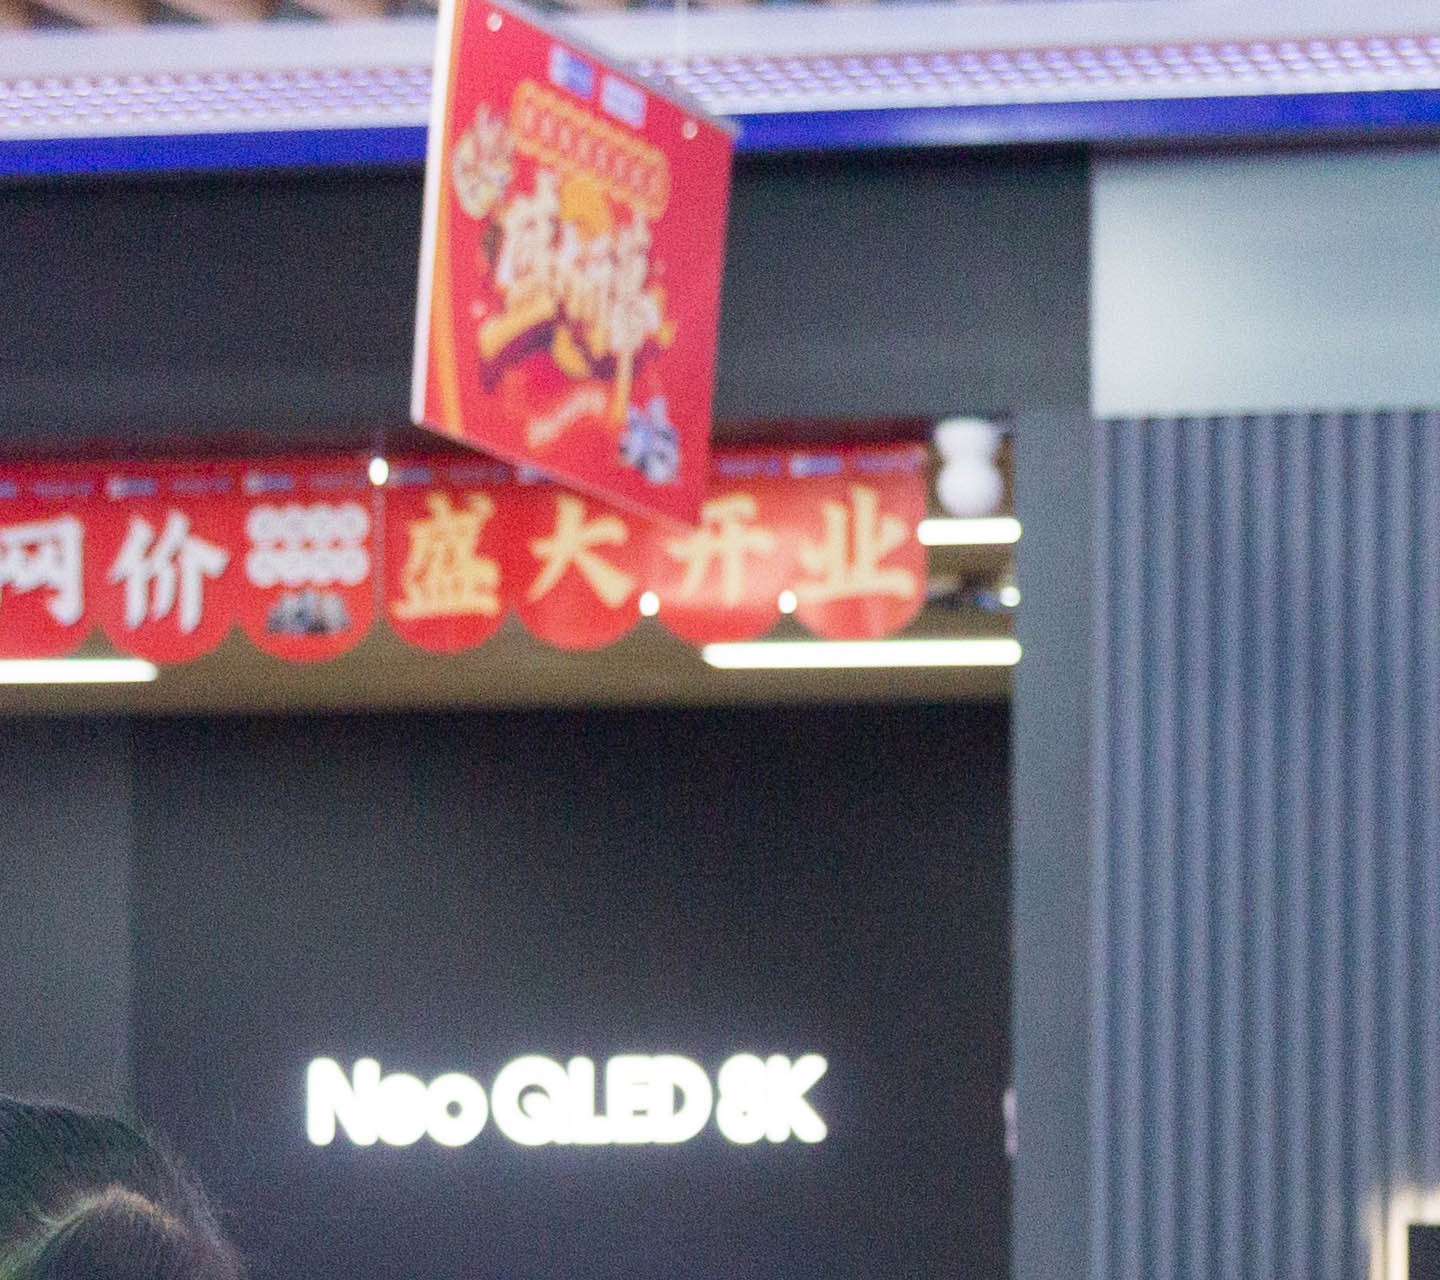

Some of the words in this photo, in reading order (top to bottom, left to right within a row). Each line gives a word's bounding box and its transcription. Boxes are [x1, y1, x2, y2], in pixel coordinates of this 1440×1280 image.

[305, 1056, 489, 1146] Neo
[491, 1053, 714, 1146] QLED
[715, 1053, 828, 1143] 8K
